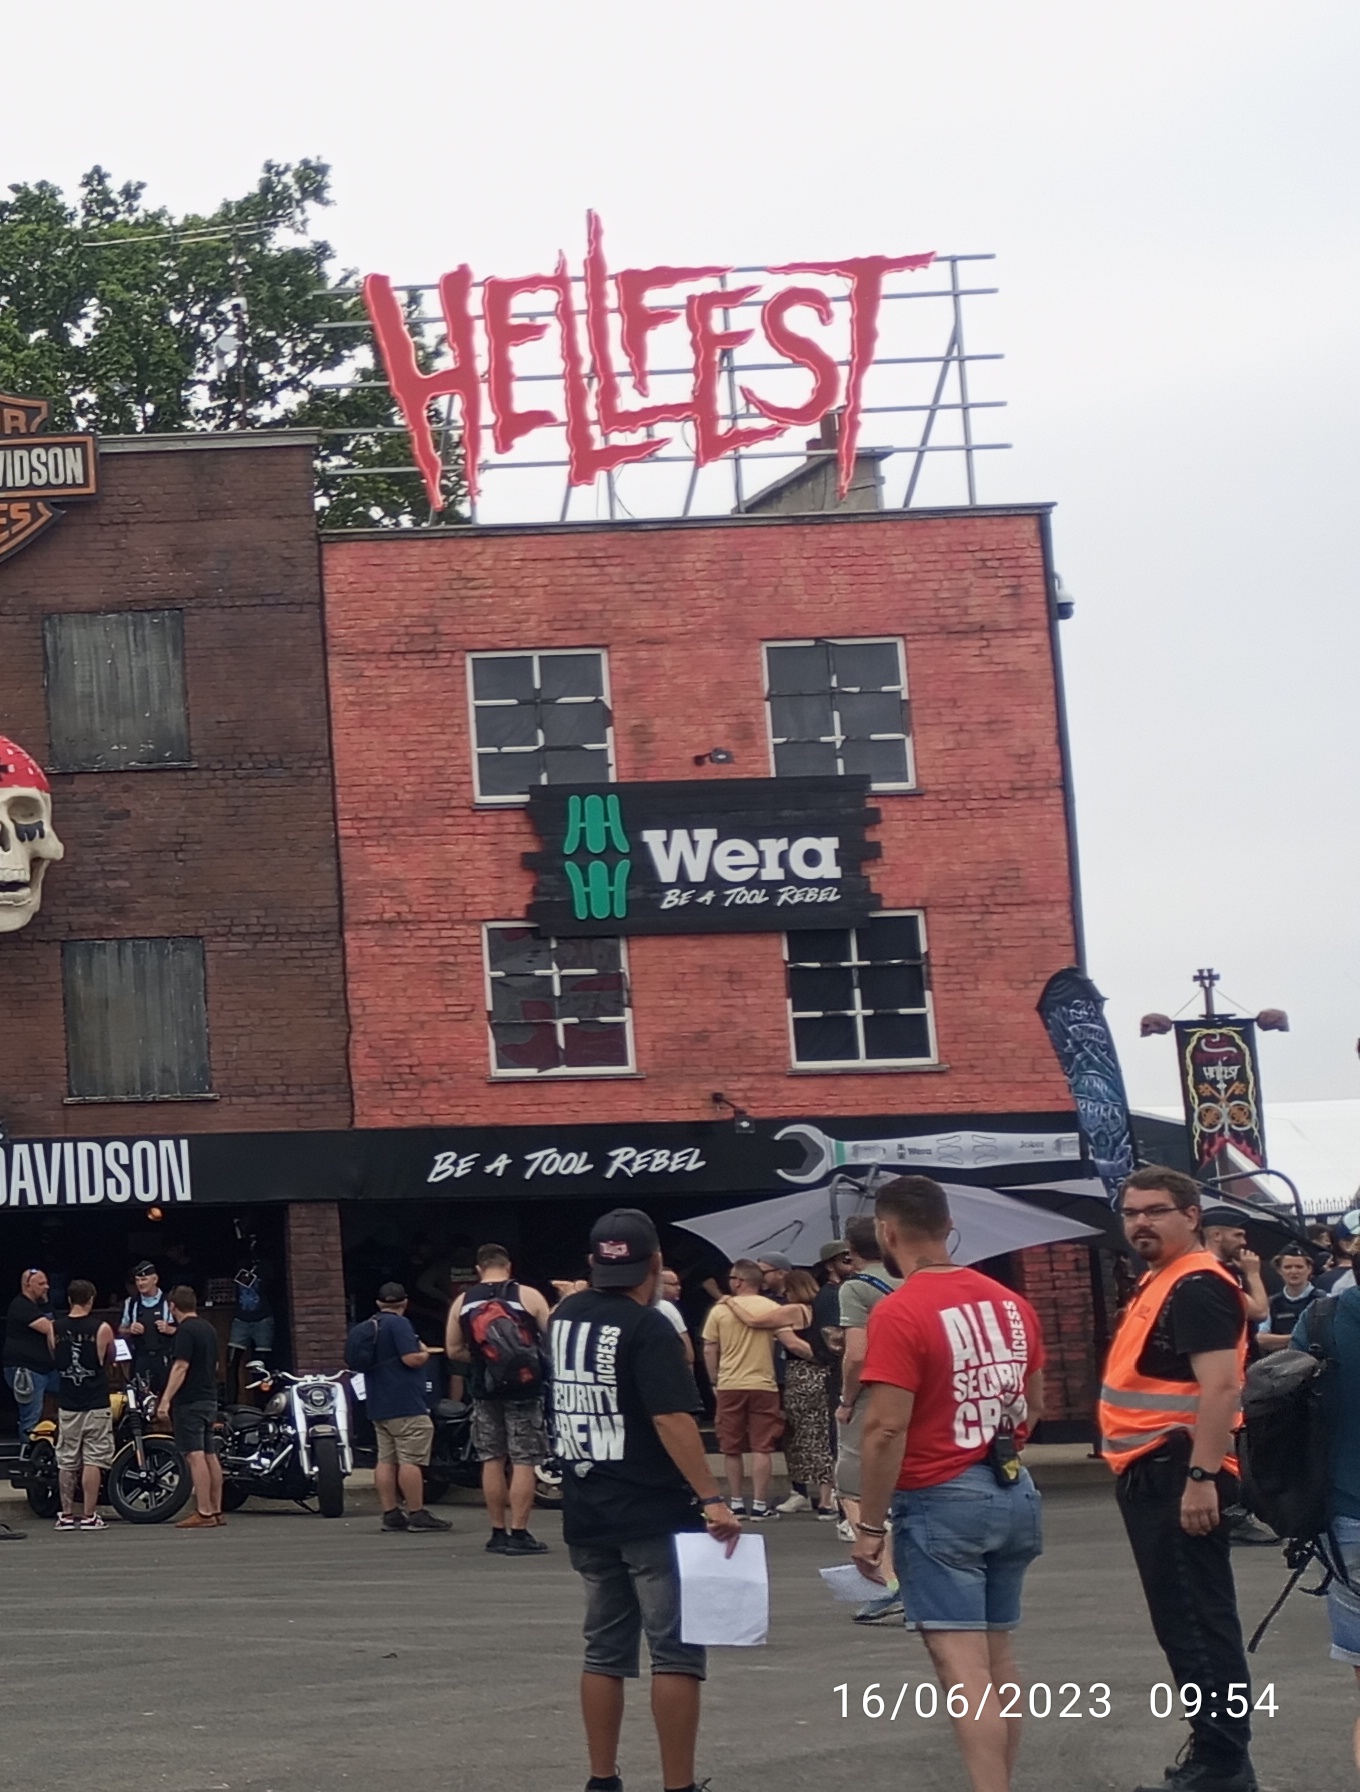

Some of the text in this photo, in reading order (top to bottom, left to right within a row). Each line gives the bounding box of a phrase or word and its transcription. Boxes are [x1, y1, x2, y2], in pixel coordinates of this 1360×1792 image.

[363, 208, 937, 512] HELLFEST
[641, 828, 843, 883] Wera
[659, 885, 841, 910] BE A TOOL REBEL
[427, 1147, 706, 1183] BE A TOOL REBEL
[596, 1324, 622, 1385] ACCESS
[939, 1300, 1013, 1372] ALL
[1003, 1300, 1028, 1362] ACCESS
[953, 1395, 1028, 1450] CR
